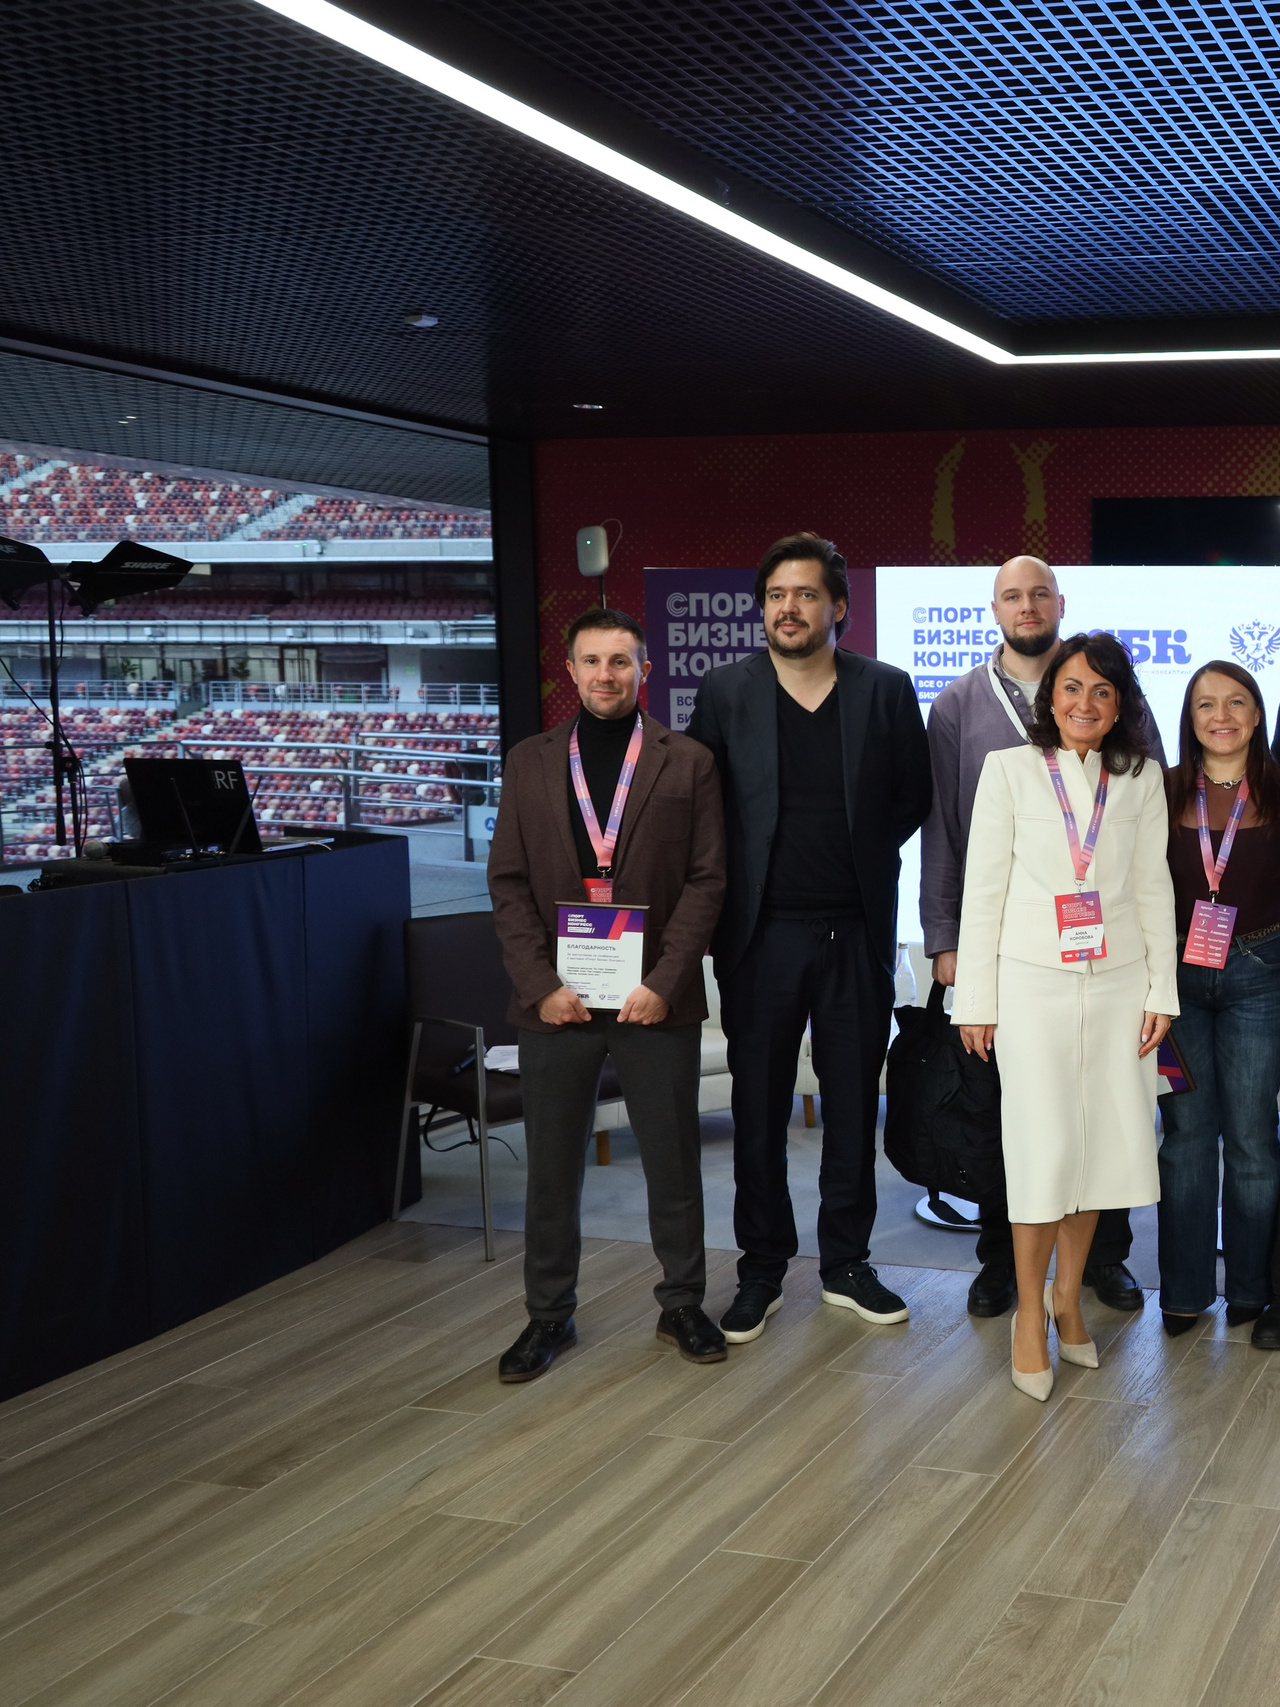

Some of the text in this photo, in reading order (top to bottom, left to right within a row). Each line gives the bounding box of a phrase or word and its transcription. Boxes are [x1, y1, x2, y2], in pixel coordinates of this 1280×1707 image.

[120, 561, 172, 570] SHURE
[666, 592, 764, 617] СПОР
[913, 607, 986, 623] СПОРТ
[667, 622, 769, 648] БИЗНЕ
[913, 629, 999, 645] БИЗНЕС
[1088, 629, 1192, 665] БК
[918, 680, 935, 689] ВСЕ
[936, 680, 943, 689] О
[676, 696, 697, 707] ВС
[918, 692, 941, 700] БИЗН
[676, 713, 692, 724] БИ
[214, 770, 239, 790] RF
